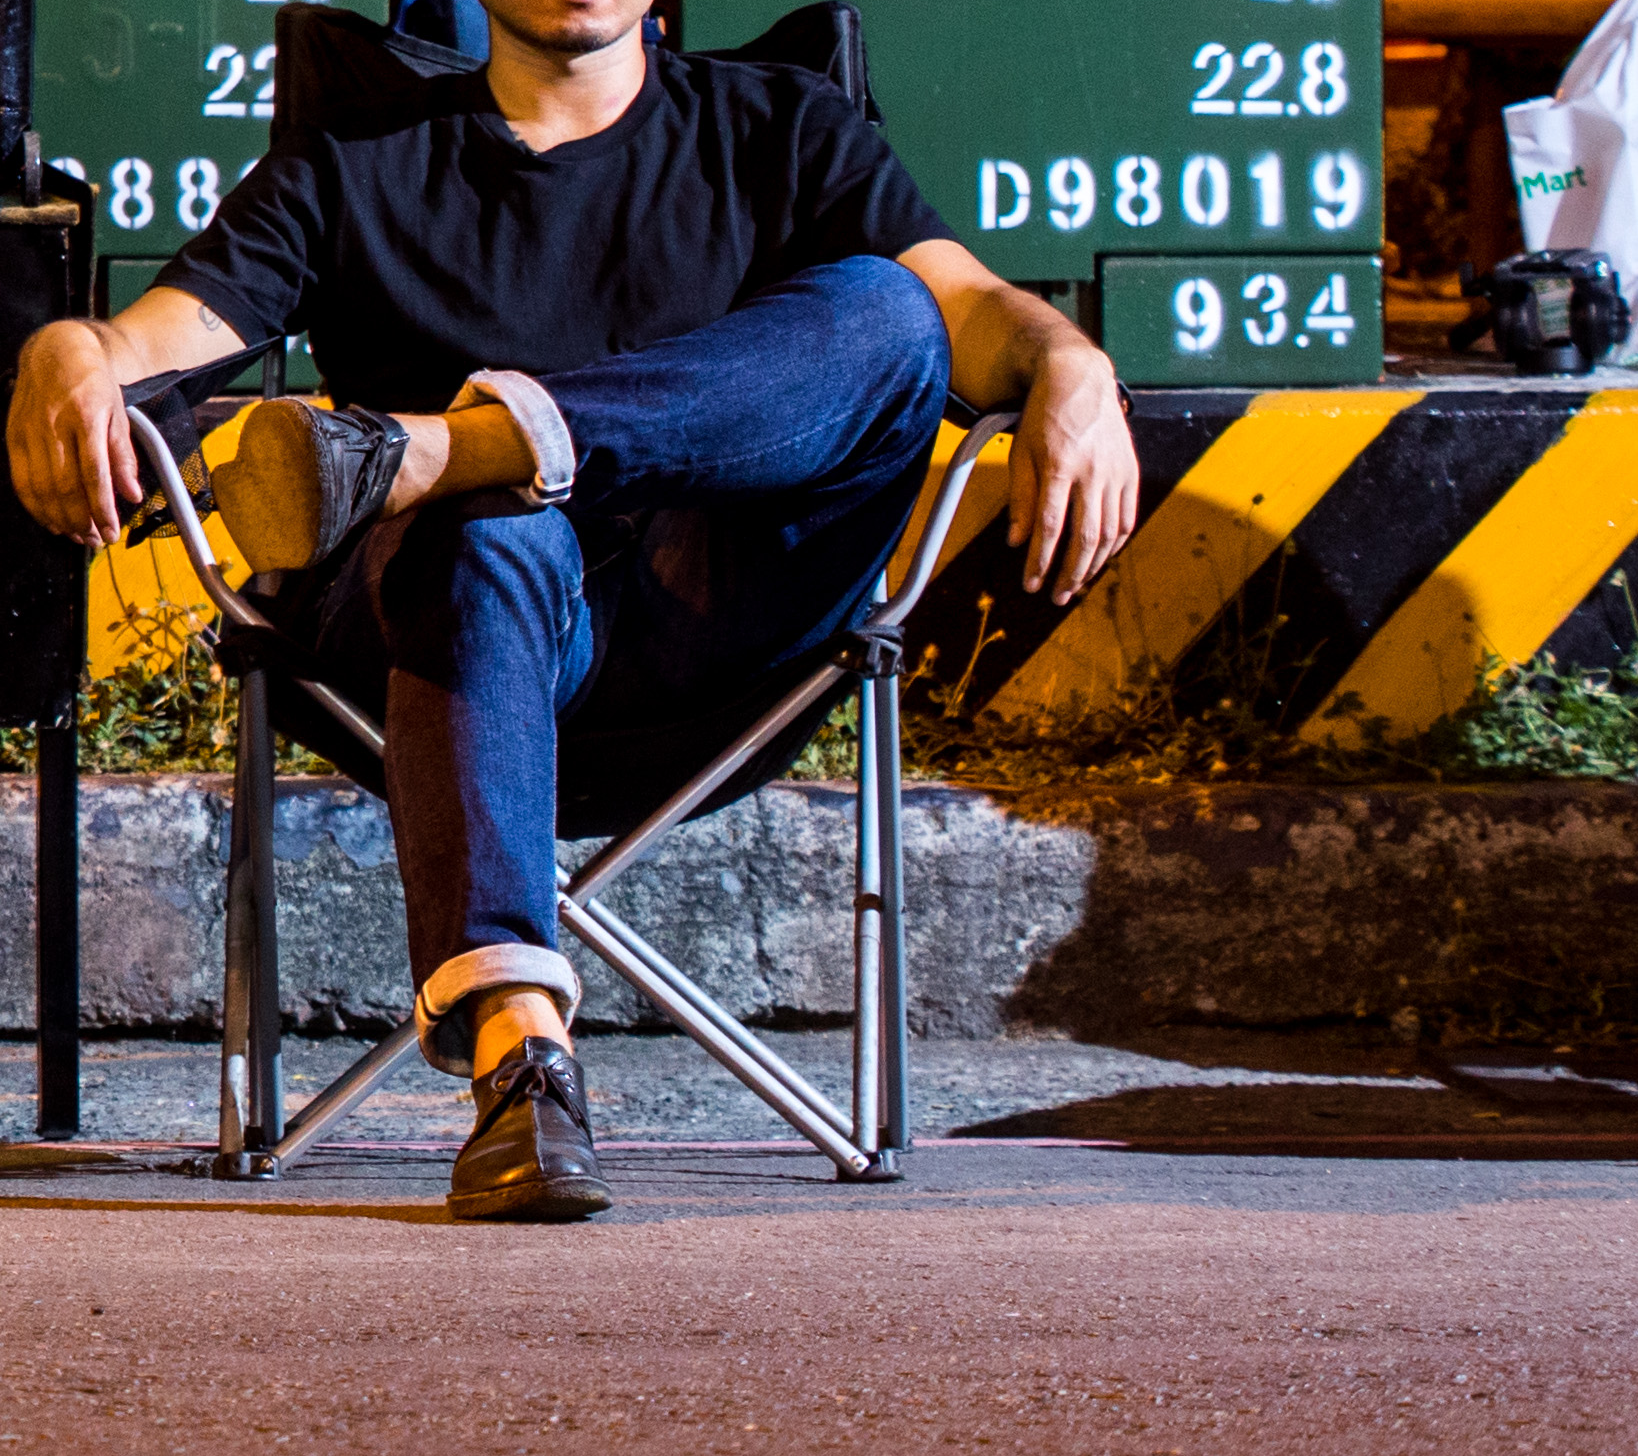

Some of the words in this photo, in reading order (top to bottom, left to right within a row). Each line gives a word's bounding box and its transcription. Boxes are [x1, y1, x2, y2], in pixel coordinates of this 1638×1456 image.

[1190, 42, 1349, 117] 22.8
[978, 151, 1365, 231] D98019
[1518, 165, 1587, 199] Mart
[1172, 273, 1355, 352] 93.4
